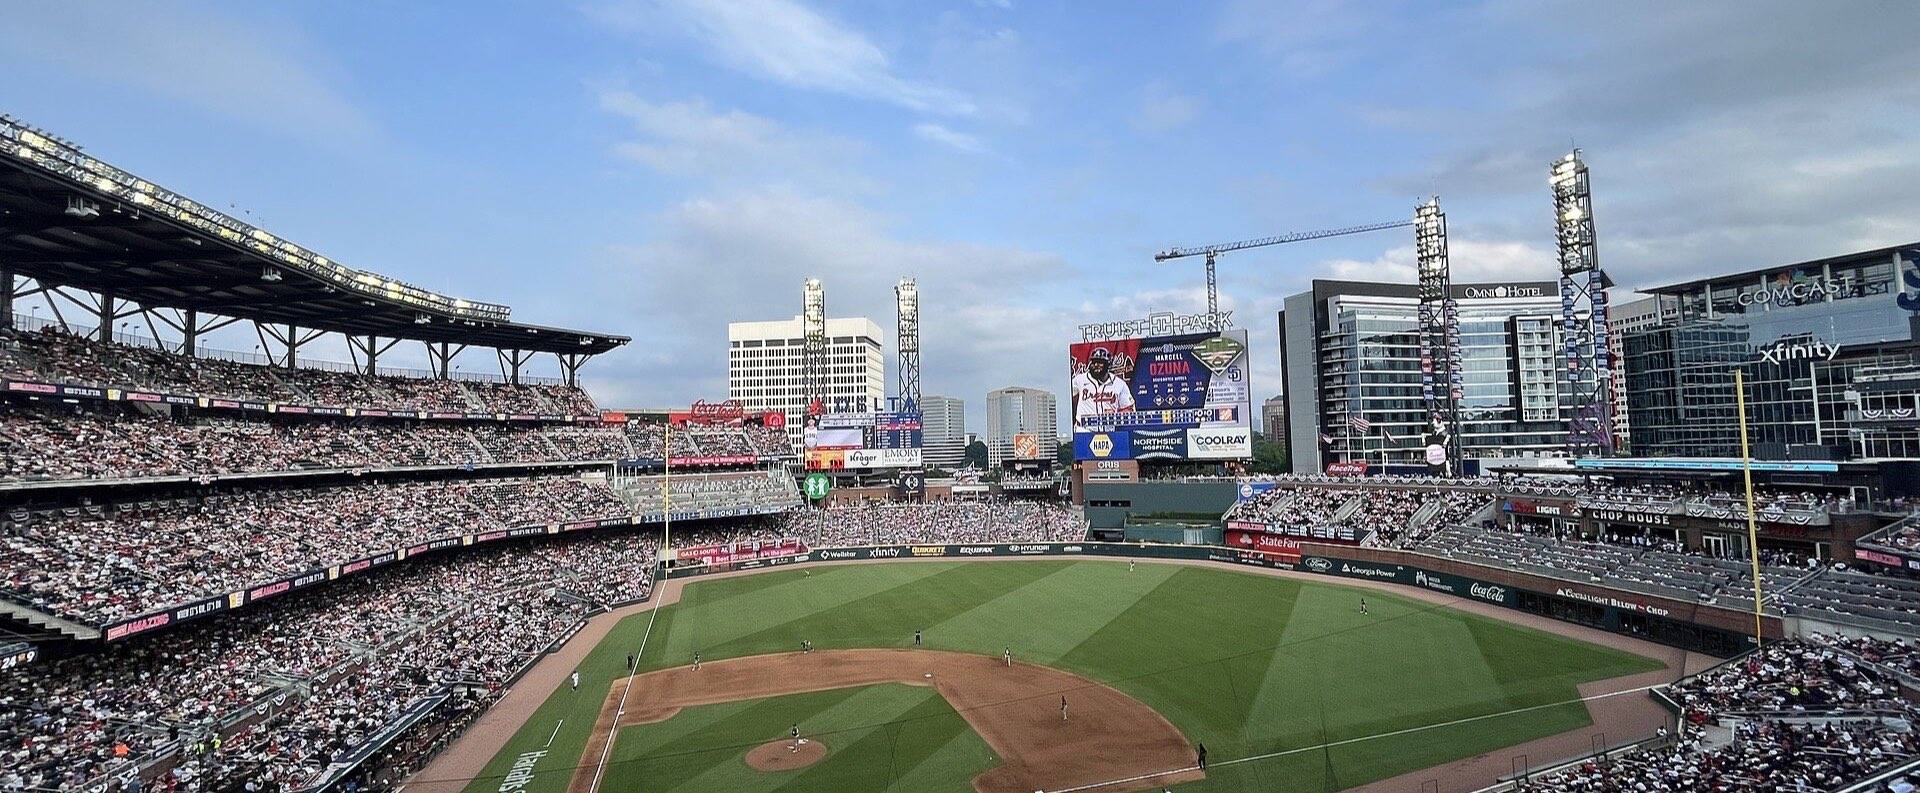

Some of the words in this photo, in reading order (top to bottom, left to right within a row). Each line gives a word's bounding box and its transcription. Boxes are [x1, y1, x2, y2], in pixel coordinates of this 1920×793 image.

[1465, 287, 1495, 298] OMNI
[1508, 286, 1543, 297] HOTEL
[1738, 276, 1854, 306] COMCAST
[1079, 319, 1146, 339] TRUIST
[1178, 310, 1233, 331] PARK
[1155, 353, 1183, 361] MARCELL
[1760, 340, 1841, 365] xfinity
[1150, 361, 1190, 375] OZUNA
[1093, 441, 1110, 450] NAPA
[1133, 437, 1183, 445] NORTHSIDE
[1196, 435, 1247, 445] COOLRAY
[850, 451, 877, 466] Kroger
[885, 449, 919, 457] EMORY
[1329, 464, 1363, 473] RaceTrac
[1536, 506, 1560, 515] LIGHT
[1593, 510, 1623, 520] CHOP
[1628, 513, 1670, 525] HOUSE
[869, 547, 900, 558] xfinity
[960, 546, 993, 555] EQUIFAX
[1309, 559, 1327, 568] Ford
[1351, 566, 1376, 577] Georgia
[1376, 568, 1396, 578] Power
[1588, 595, 1608, 605] LIGHT
[1611, 598, 1637, 610] BELOW
[1646, 605, 1669, 617] CHOP
